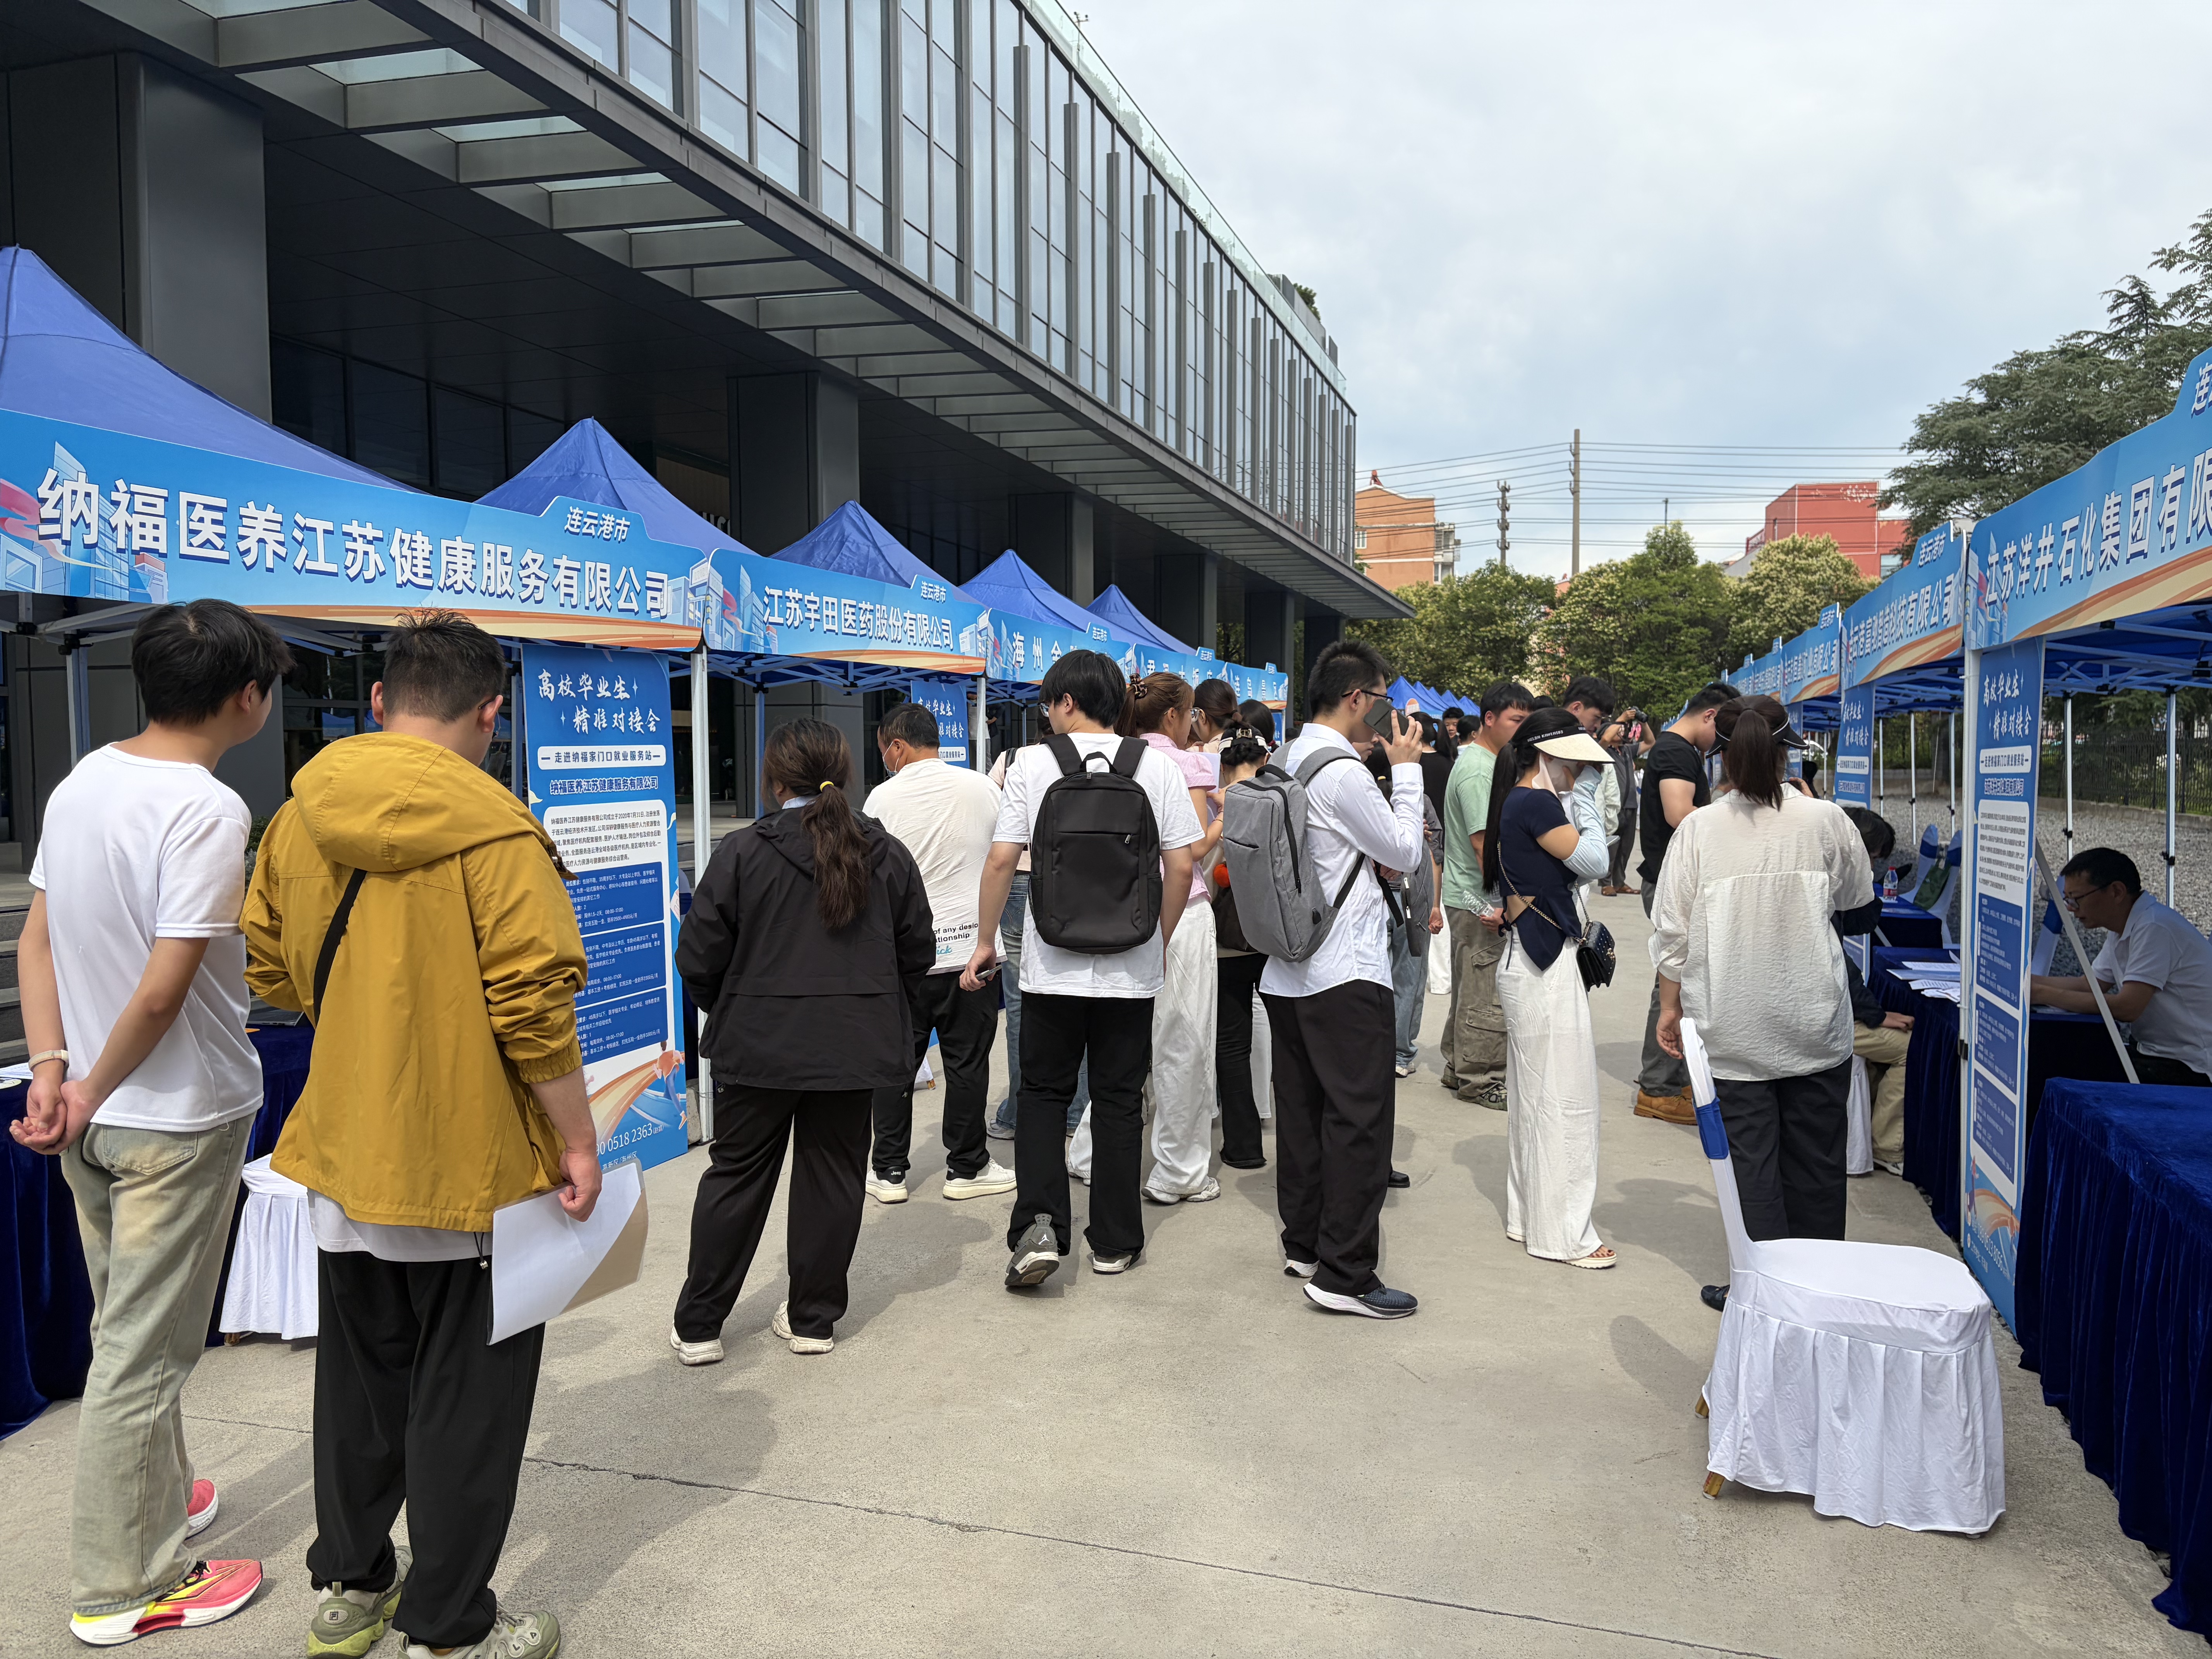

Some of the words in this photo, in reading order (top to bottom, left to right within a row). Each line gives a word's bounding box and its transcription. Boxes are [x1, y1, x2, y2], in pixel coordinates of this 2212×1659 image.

[2191, 362, 2212, 419] 连
[564, 505, 631, 543] 连云港市
[1985, 448, 2212, 606] 江苏洋井石化集团有限
[37, 468, 671, 620] 纳福医养江苏健康服务有限公司
[1917, 532, 1946, 568] 连云港市
[921, 581, 947, 603] 连云港市
[763, 586, 954, 651] 江苏宇田医药股份有限公司
[538, 668, 630, 701] 高校毕业生
[1983, 668, 2020, 708] 高校毕业生
[573, 705, 661, 734] 精准对接会
[1992, 704, 2032, 741] 精准对接会
[555, 750, 652, 764] 走进纳福家门口就业服务站
[550, 776, 659, 795] 纳福医养江苏健康服务有限公司
[608, 1132, 630, 1152] 0518
[631, 1123, 653, 1143] 2363
